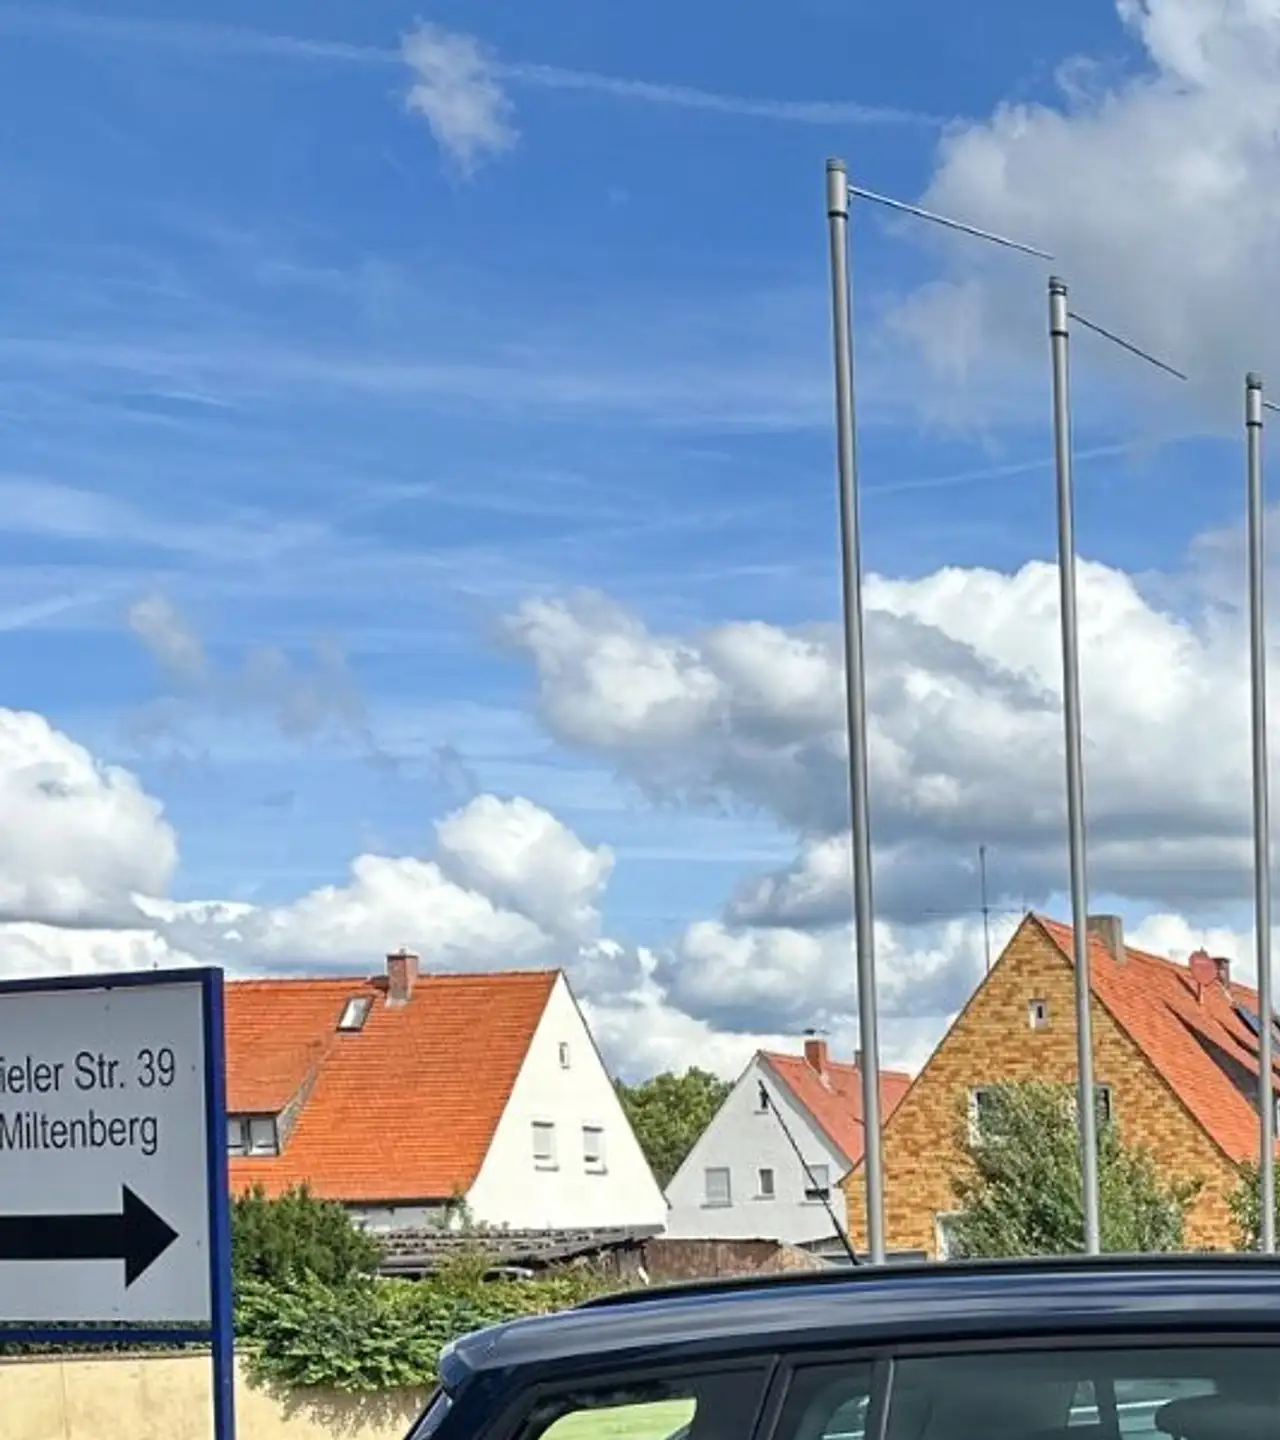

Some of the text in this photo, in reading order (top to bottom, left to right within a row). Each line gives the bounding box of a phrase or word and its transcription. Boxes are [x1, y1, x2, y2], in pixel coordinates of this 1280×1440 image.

[75, 1051, 125, 1091] Str.
[137, 1048, 175, 1087] 39
[0, 1108, 158, 1156] Miltenberg
